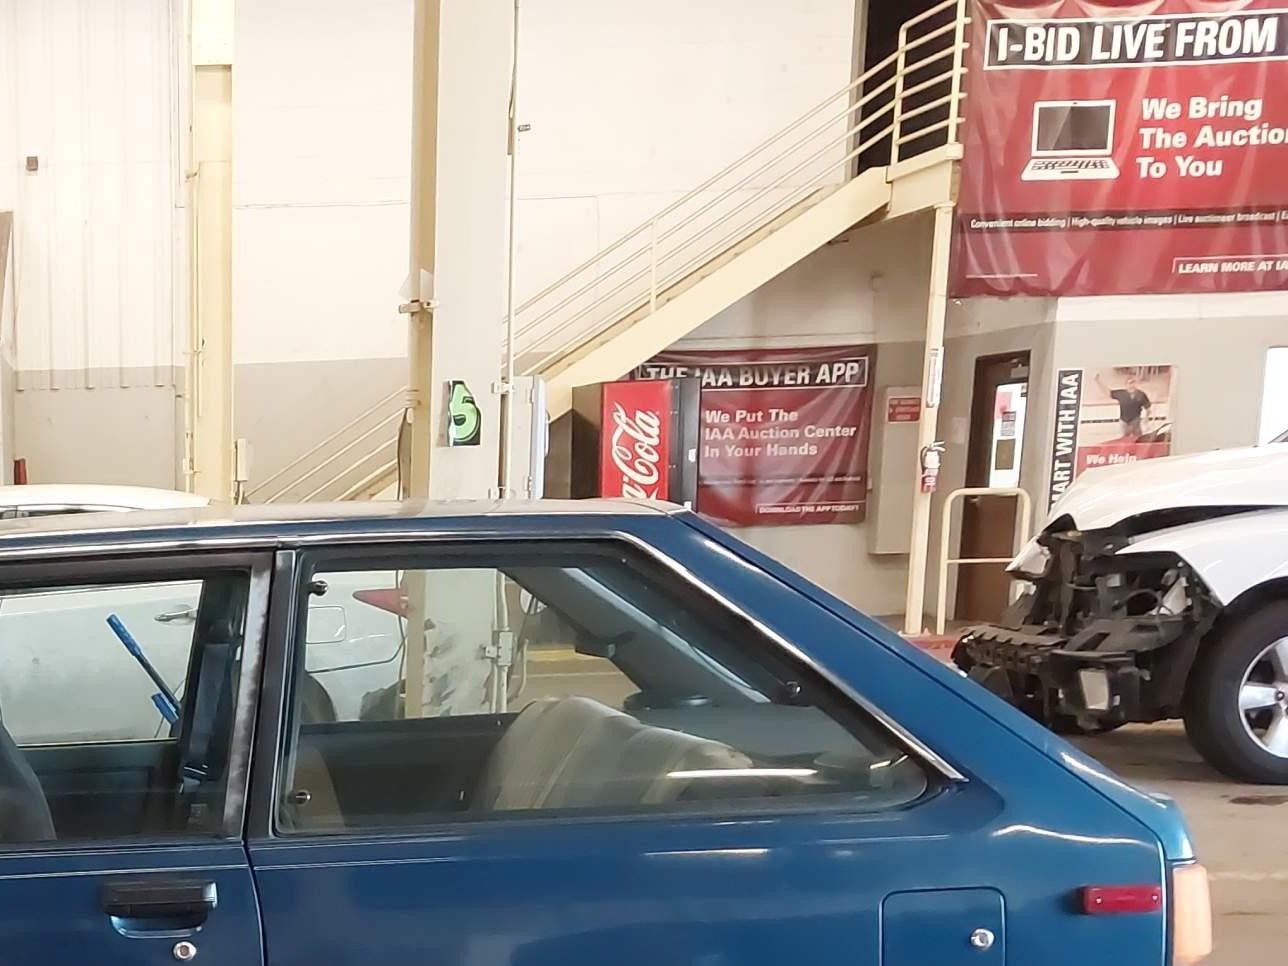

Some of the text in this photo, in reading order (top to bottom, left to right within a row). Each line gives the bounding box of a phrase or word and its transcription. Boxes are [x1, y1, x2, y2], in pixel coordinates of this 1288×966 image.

[997, 17, 1279, 62] I-BID LIVE FROM
[1141, 96, 1263, 121] We Bring
[1139, 127, 1187, 149] The
[1136, 156, 1223, 178] To You
[1178, 263, 1218, 273] LEARN
[1221, 262, 1256, 272] MORE
[1257, 261, 1274, 271] AT
[739, 366, 810, 386] BUYER
[816, 362, 859, 384] APP
[1060, 374, 1079, 404] IAA
[705, 409, 798, 423] We Put The
[705, 425, 856, 441] IAA Auction Center
[1055, 409, 1076, 456] WITH
[704, 443, 818, 458] In Your Hands
[1086, 454, 1105, 464] We
